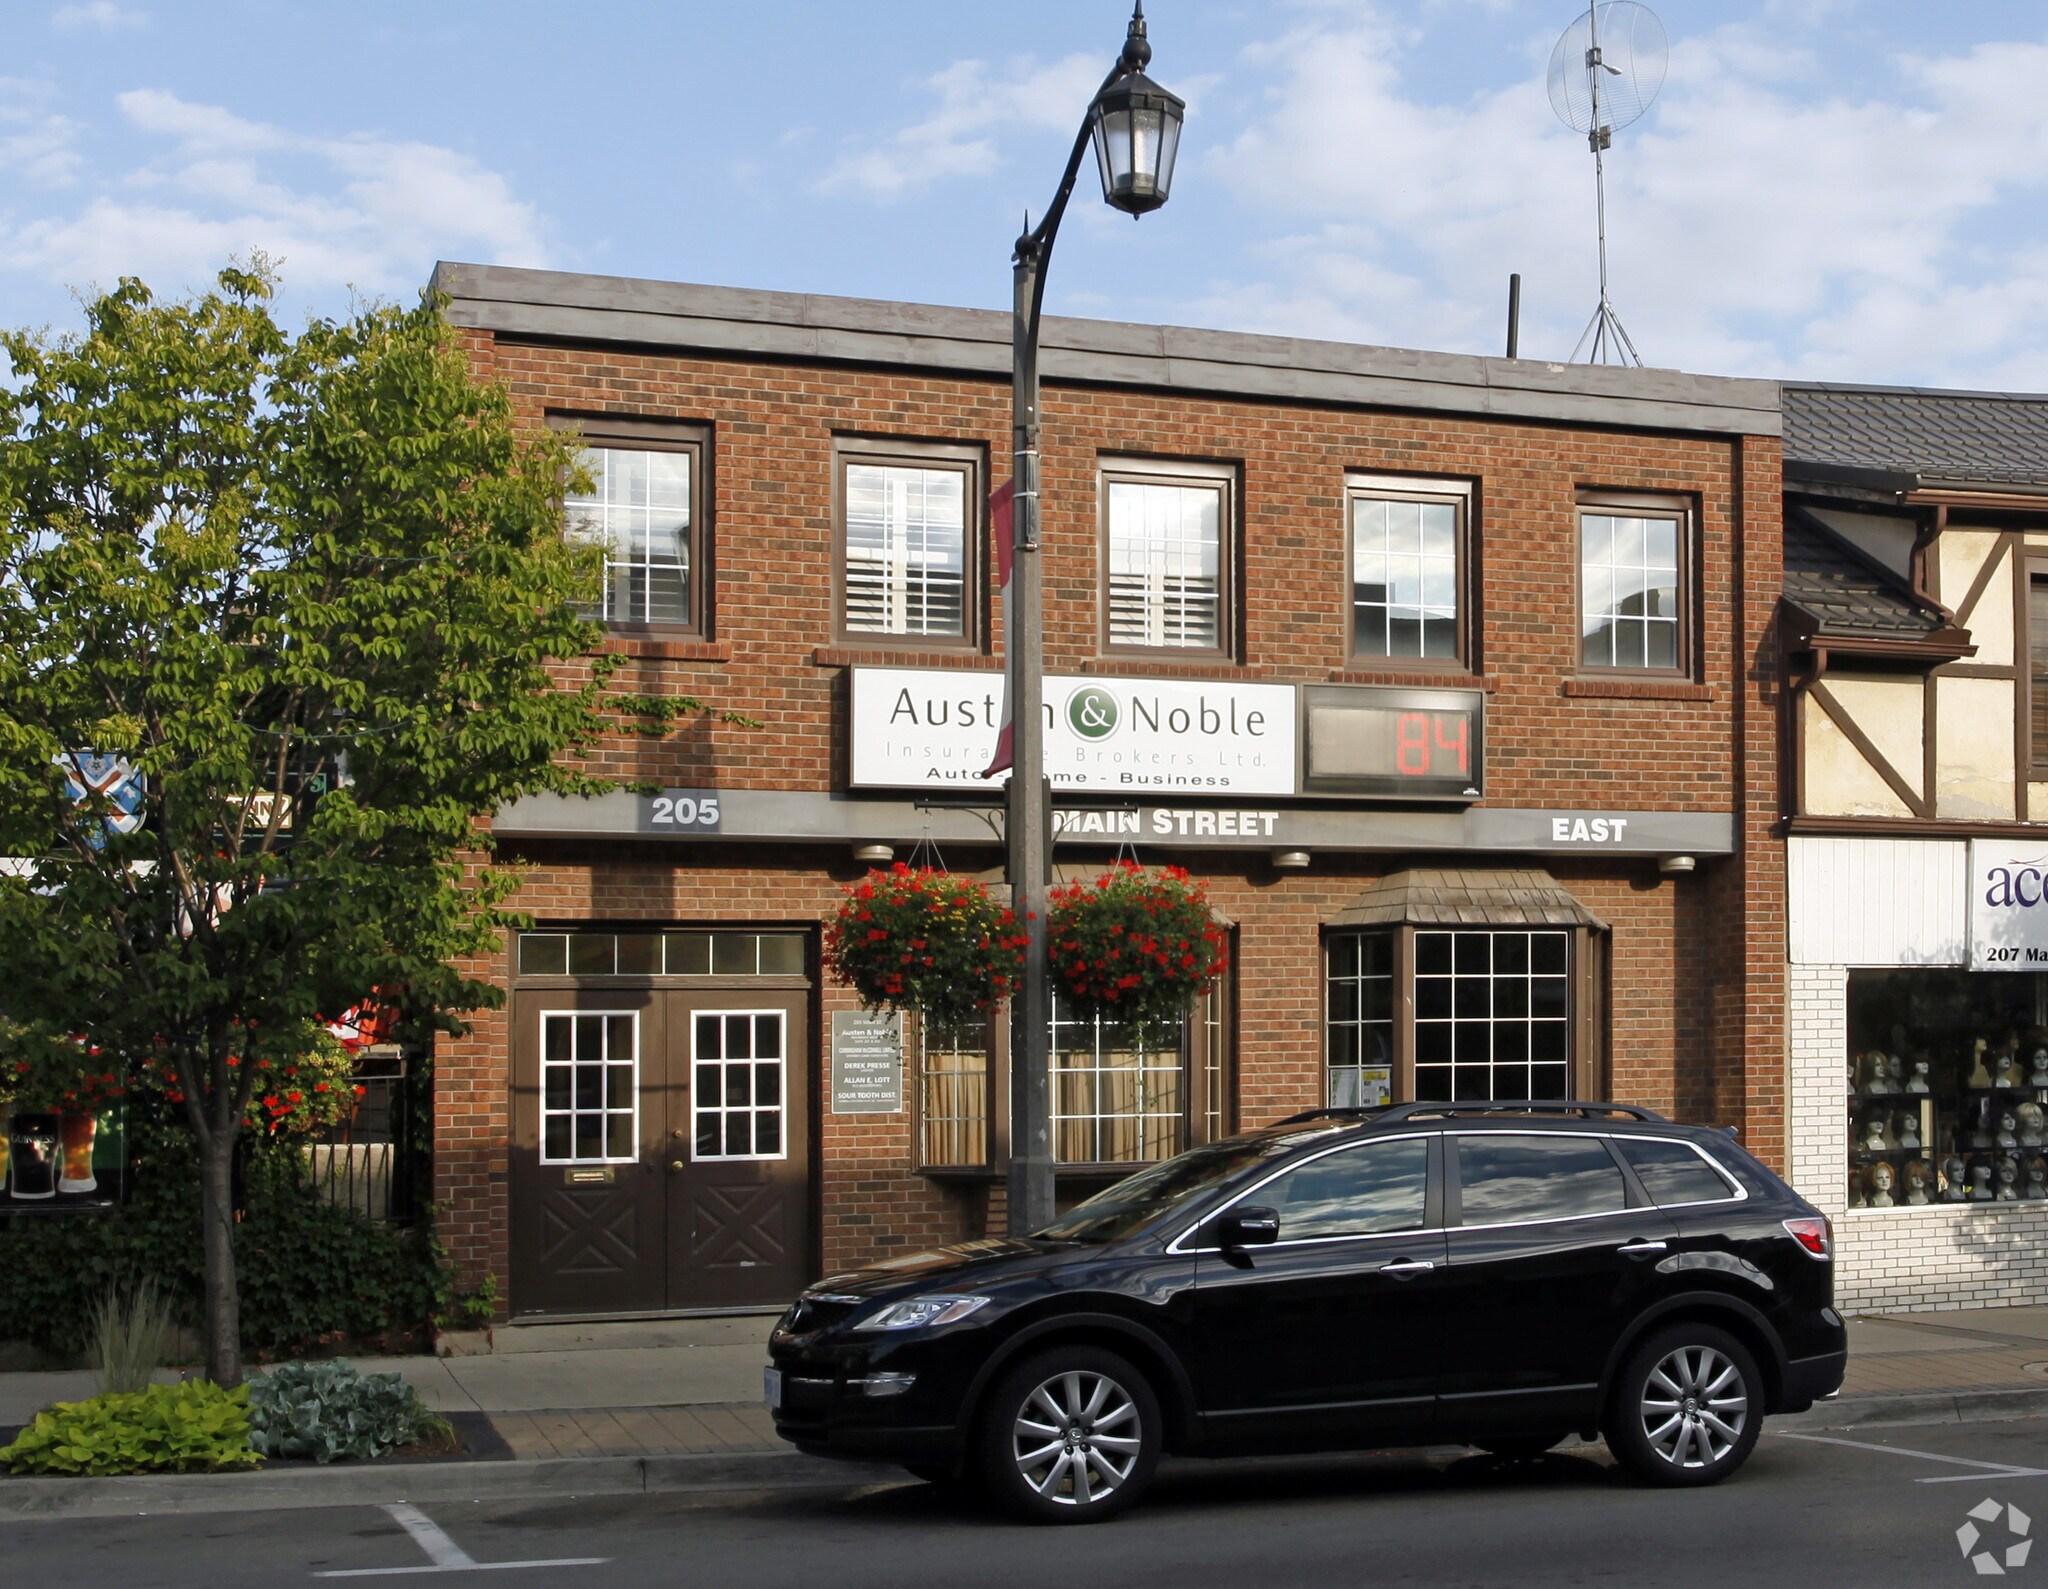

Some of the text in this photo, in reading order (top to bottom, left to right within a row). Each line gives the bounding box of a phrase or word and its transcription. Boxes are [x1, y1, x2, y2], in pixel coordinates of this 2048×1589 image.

[890, 687, 1265, 736] Austn & Noble
[887, 741, 1266, 767] Insurae Brokers Ltd.
[1396, 712, 1468, 776] 84
[926, 767, 985, 780] Auto
[1042, 771, 1087, 783] me
[1120, 772, 1230, 786] Business
[652, 797, 1628, 842] 205 MAIN STREET EAST
[1985, 867, 2048, 908] ac
[1986, 947, 2048, 962] 207 Ma
